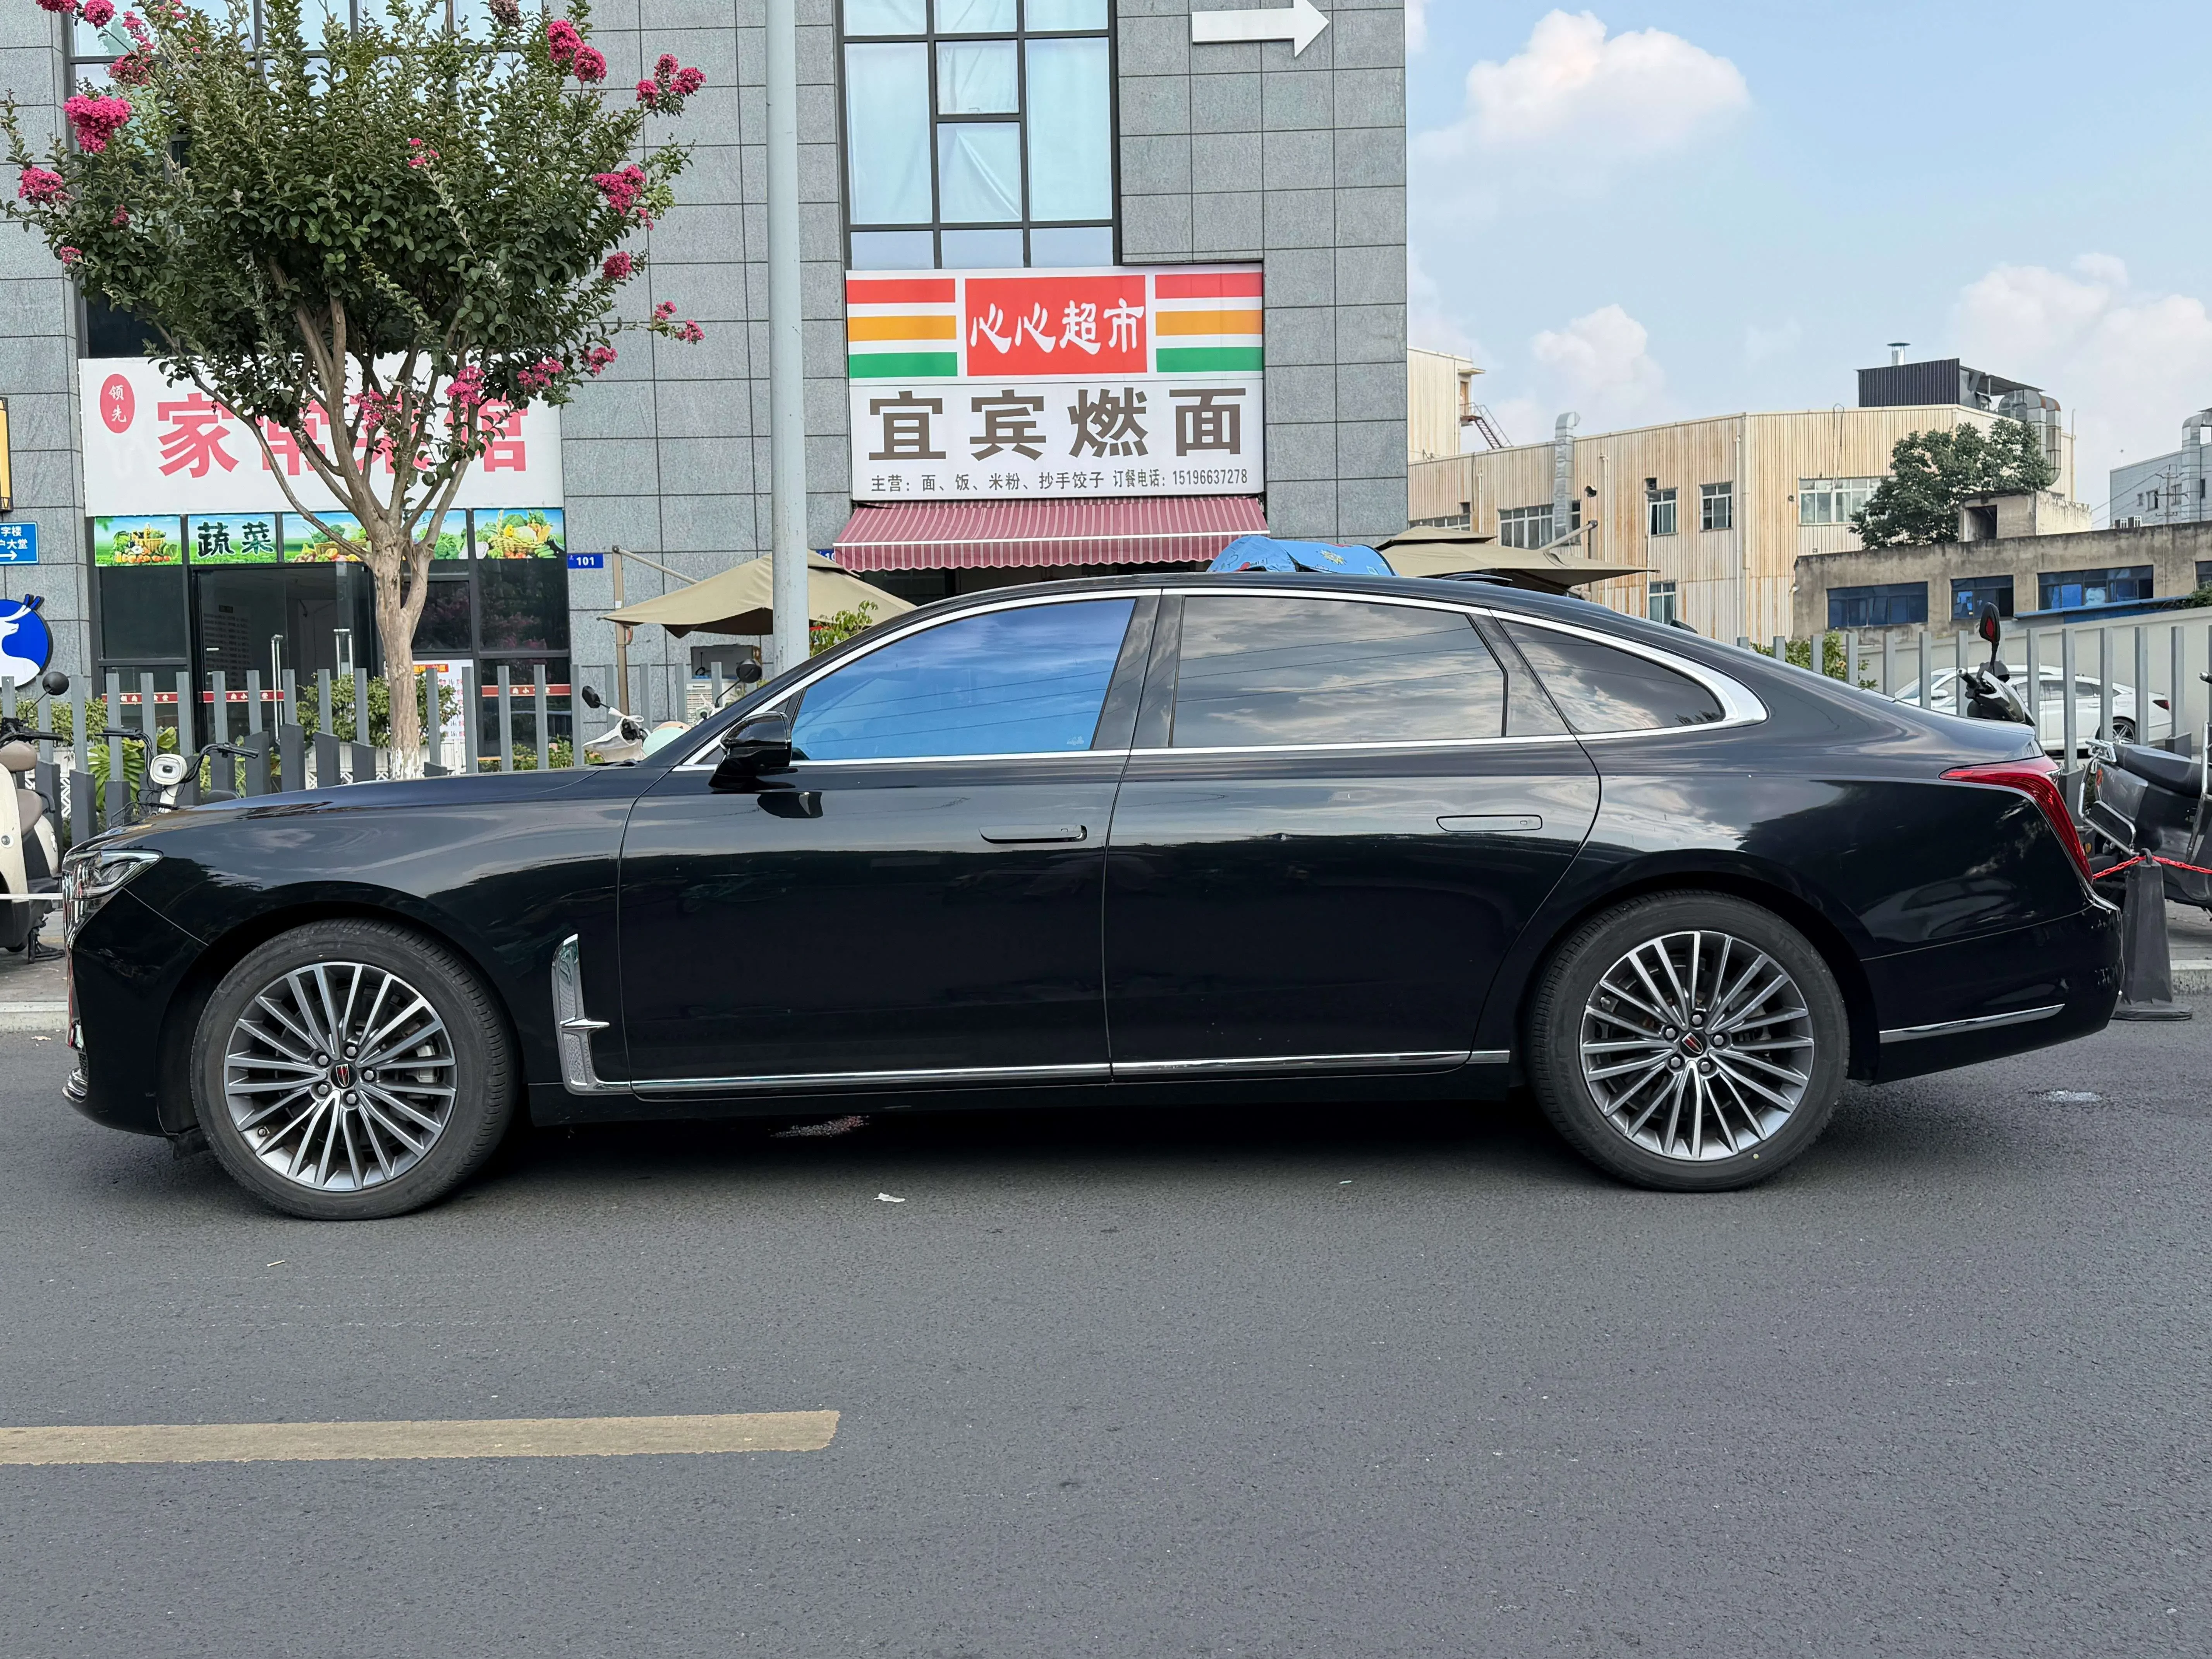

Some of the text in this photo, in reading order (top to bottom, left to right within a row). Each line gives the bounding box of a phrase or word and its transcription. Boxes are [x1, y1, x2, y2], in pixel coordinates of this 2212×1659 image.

[970, 298, 1144, 355] 心心超市
[108, 385, 127, 422] 领先
[869, 388, 1246, 461] 宜宾燃面
[198, 521, 273, 557] 蔬菜
[576, 556, 594, 566] 101
